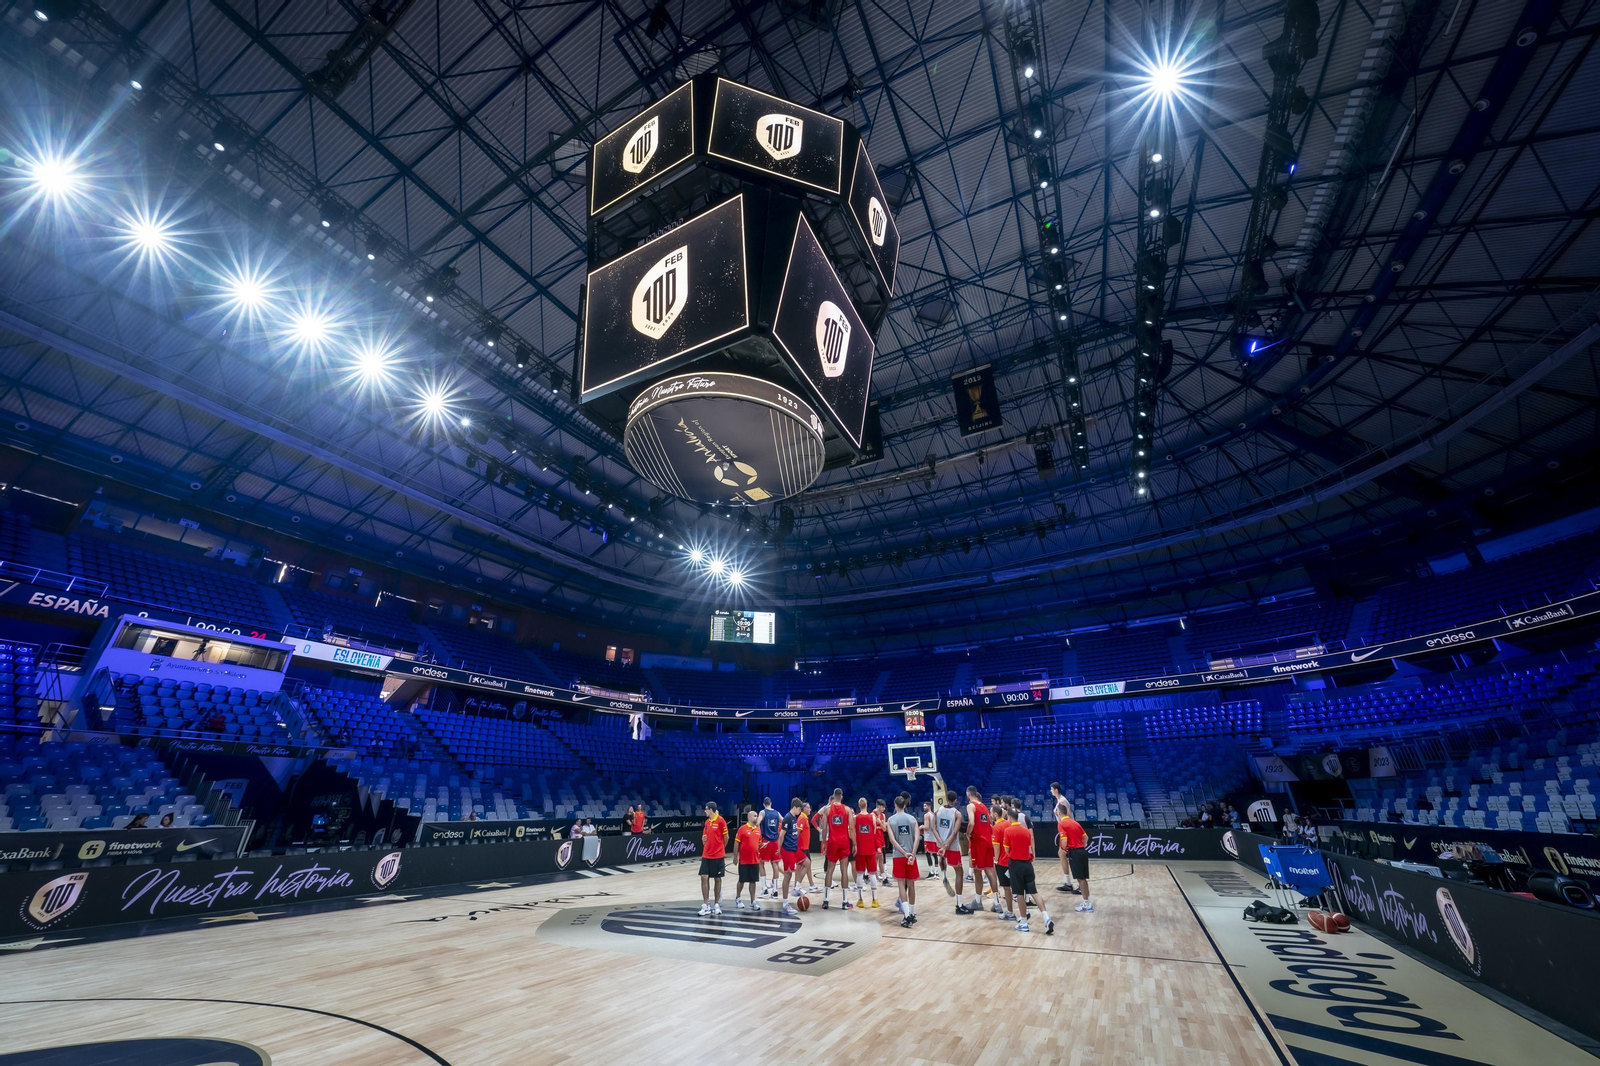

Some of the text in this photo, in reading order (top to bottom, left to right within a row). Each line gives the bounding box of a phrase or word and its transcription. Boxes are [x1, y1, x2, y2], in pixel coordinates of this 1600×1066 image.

[785, 117, 800, 127] FEB
[765, 123, 794, 152] 100
[629, 129, 652, 165] 100
[664, 252, 683, 268] FEB
[642, 267, 677, 325] 100
[823, 317, 844, 364] 100
[775, 393, 798, 410] 1923
[27, 591, 110, 619] ESPAÑA
[1524, 606, 1569, 625] CaixaBank
[1425, 630, 1476, 648] endesa
[332, 648, 382, 670] ESLOVENIA
[412, 665, 448, 679] endesa
[1272, 660, 1320, 674] finetwork
[479, 677, 505, 688] CaixaBank
[1145, 678, 1180, 689] endesa
[1213, 671, 1245, 682] CaixaBank
[524, 685, 555, 697] finetwork
[1083, 683, 1119, 696] ESLOVENIA
[609, 701, 633, 710] endesa
[946, 697, 974, 708] ESPAÑA
[1006, 692, 1029, 702] 90:00
[1032, 690, 1042, 698] 24
[691, 709, 718, 717] finetwork
[774, 710, 798, 718] endesa
[856, 706, 884, 714] finetwork
[906, 716, 919, 726] 24
[1265, 764, 1284, 773] 1923
[1373, 756, 1390, 767] 2023
[224, 781, 243, 790] FEB
[432, 829, 464, 839] endesa
[481, 829, 507, 837] CaixaBank
[108, 840, 163, 851] finetwork
[628, 835, 664, 861] Nuestra
[1430, 839, 1453, 853] ende
[1499, 848, 1527, 865] aBank
[380, 859, 396, 880] 100
[1288, 866, 1320, 875] molten
[121, 867, 254, 915] Nuestra
[1327, 857, 1375, 920] Nuestra
[41, 882, 77, 914] 100
[767, 938, 856, 966] FEB
